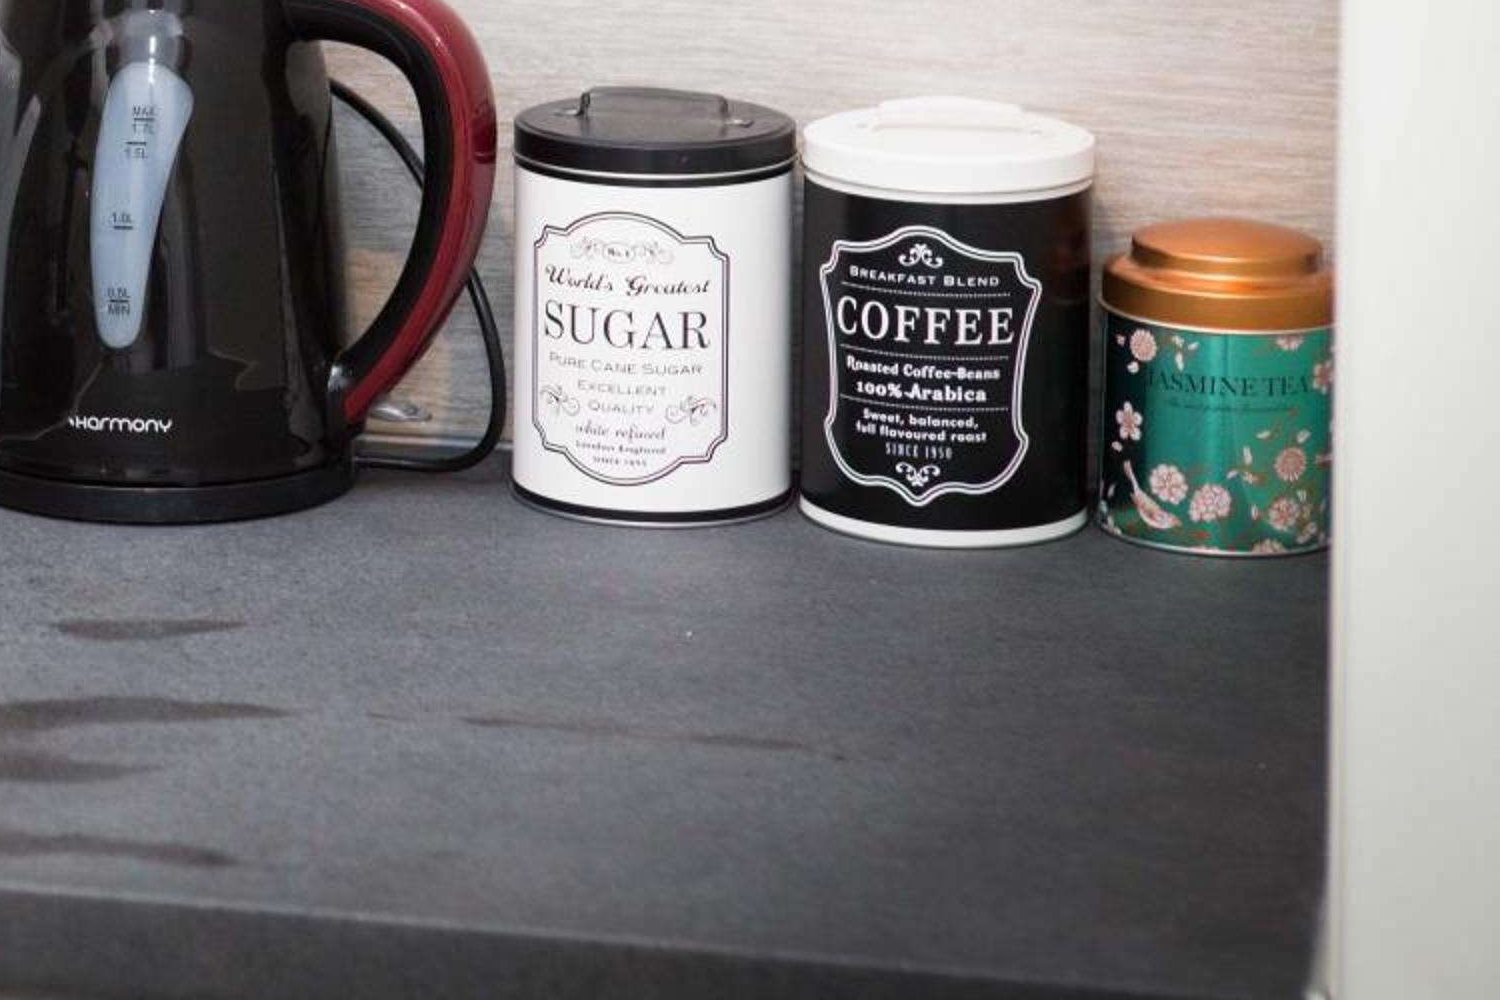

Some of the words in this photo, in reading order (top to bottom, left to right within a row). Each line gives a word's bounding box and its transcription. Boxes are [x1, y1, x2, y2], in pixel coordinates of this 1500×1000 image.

[545, 264, 613, 291] World's
[625, 274, 711, 297] Greatest
[850, 265, 937, 286] BREAKFAST
[943, 275, 1000, 287] BLEND
[544, 299, 712, 350] SUGAR
[837, 295, 1015, 346] COFFEE
[549, 351, 587, 369] PURE
[591, 359, 637, 375] CANE
[642, 363, 704, 377] SUGAR
[846, 355, 899, 376] Roasted
[577, 379, 667, 397] EXCELLENT
[856, 381, 902, 399] 100%
[904, 383, 988, 402] Arabica
[1147, 368, 1256, 398] JASMINE
[1262, 376, 1312, 398] TEA
[588, 399, 655, 415] QUALITY
[855, 420, 877, 436] full
[879, 425, 947, 442] flavoured
[950, 431, 988, 443] roast
[909, 414, 979, 430] balanced,
[885, 441, 919, 458] SINCE
